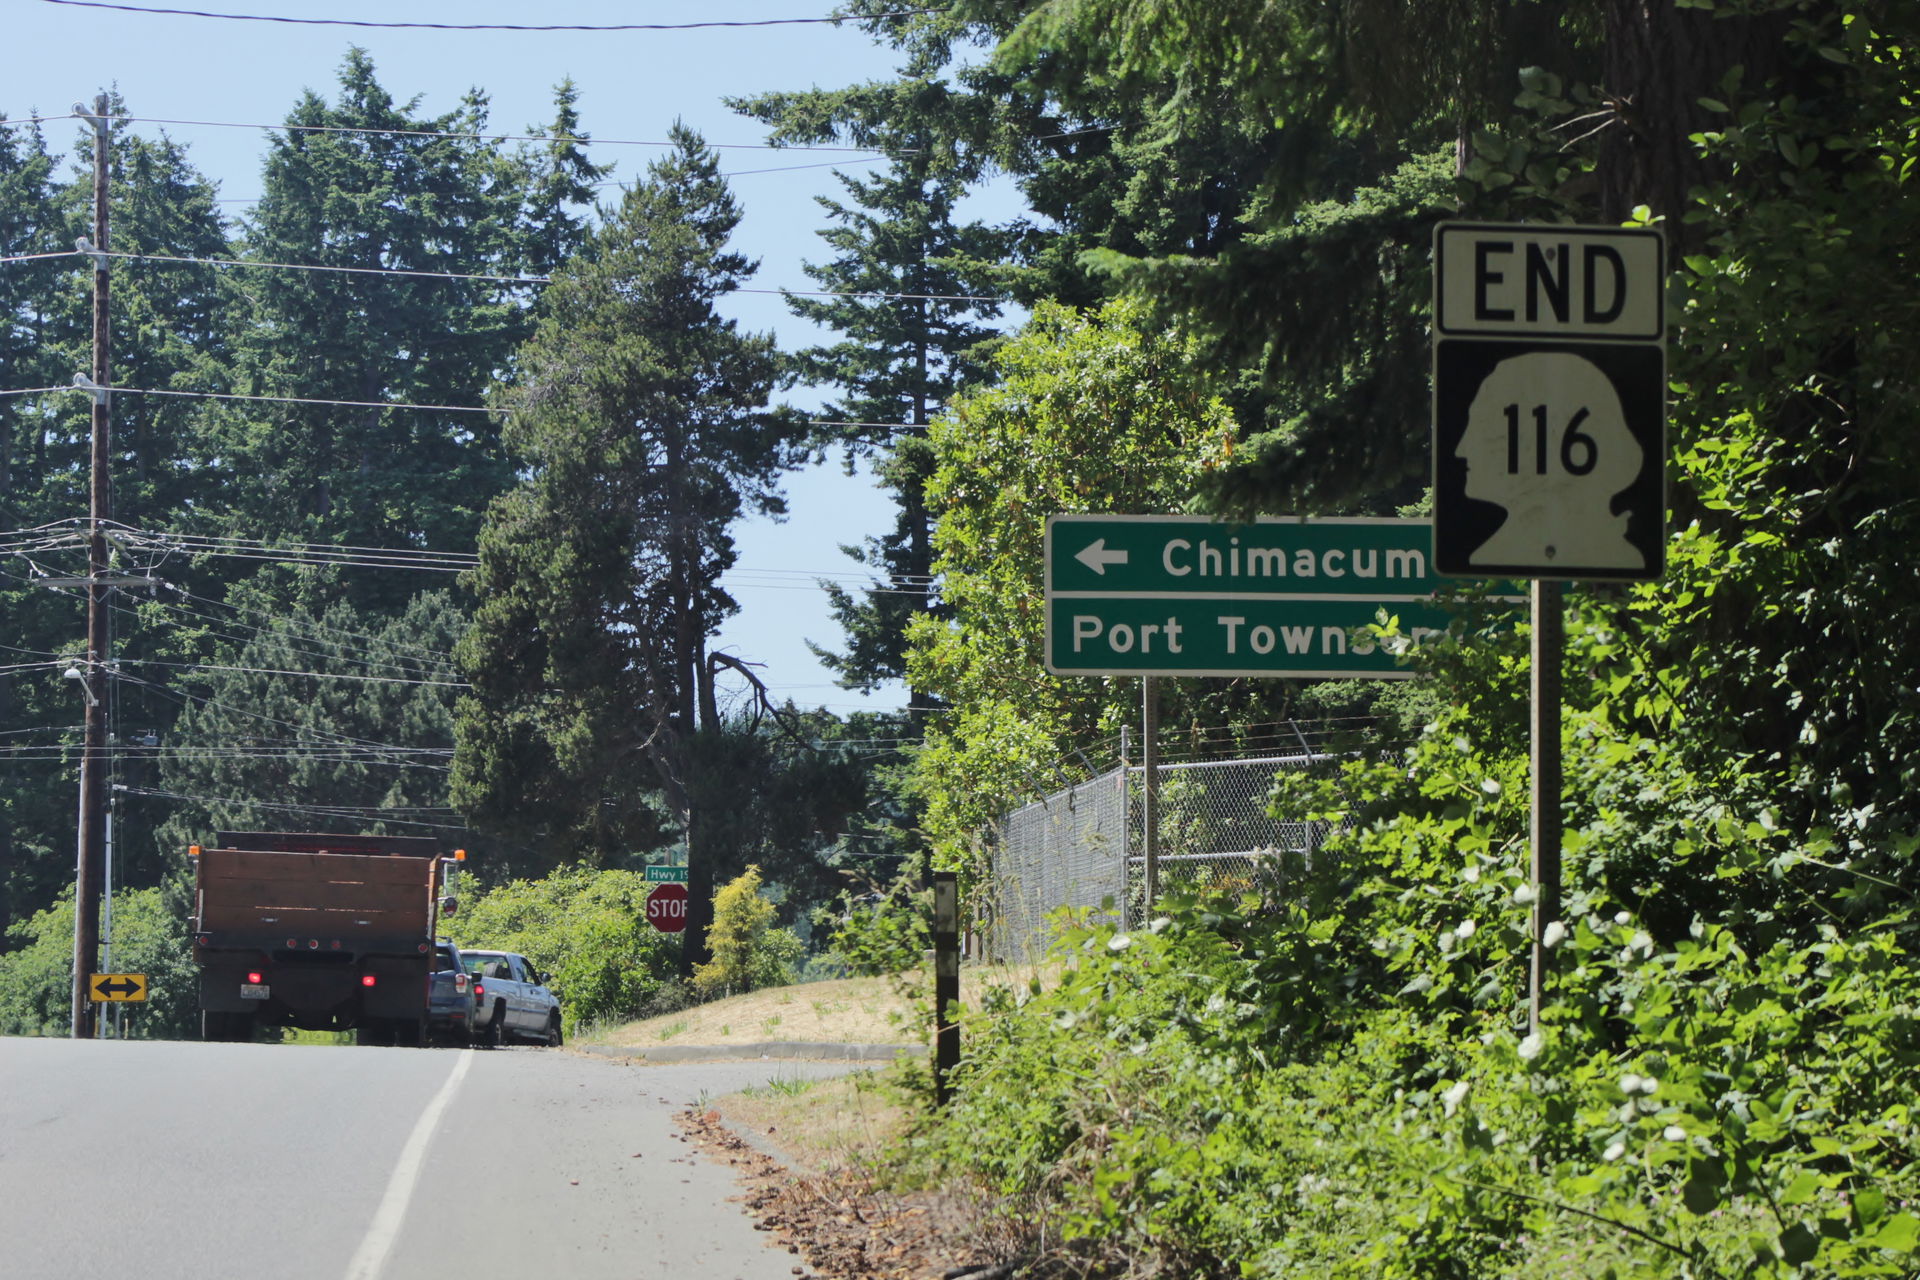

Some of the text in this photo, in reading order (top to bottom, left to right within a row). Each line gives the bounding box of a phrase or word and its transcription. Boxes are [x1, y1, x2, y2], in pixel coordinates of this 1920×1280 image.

[1475, 241, 1627, 324] END
[1503, 404, 1598, 477] 116
[1162, 537, 1425, 579] Chimacum
[1073, 615, 1183, 654] Port
[650, 869, 676, 881] Hwy
